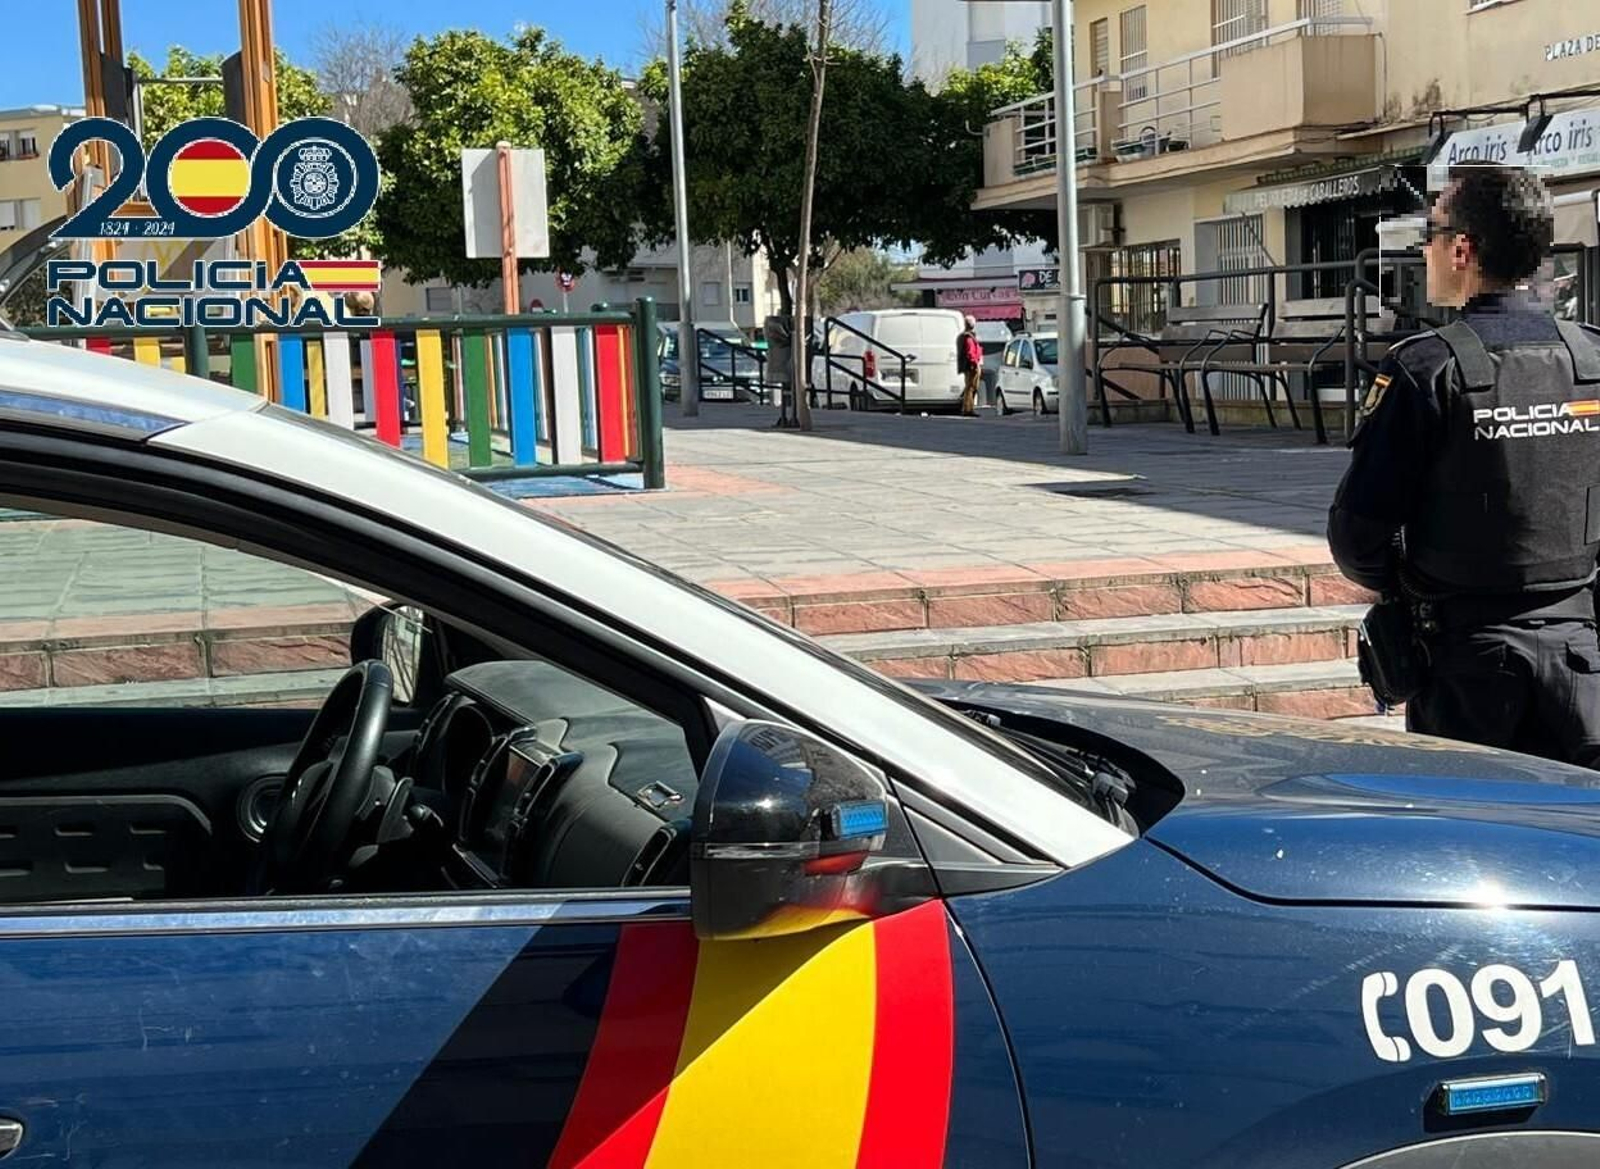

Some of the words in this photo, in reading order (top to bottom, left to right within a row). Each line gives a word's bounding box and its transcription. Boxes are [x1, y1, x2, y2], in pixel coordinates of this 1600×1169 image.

[1544, 39, 1582, 61] PLAZA
[1586, 34, 1600, 52] DE
[1568, 119, 1593, 150] iris
[1447, 142, 1480, 165] Arco
[1484, 134, 1508, 161] iris
[1309, 175, 1360, 201] CABALLEROS
[1473, 402, 1573, 423] POLICIA
[1474, 418, 1600, 441] NACIONAL
[1404, 959, 1596, 1058] 091
